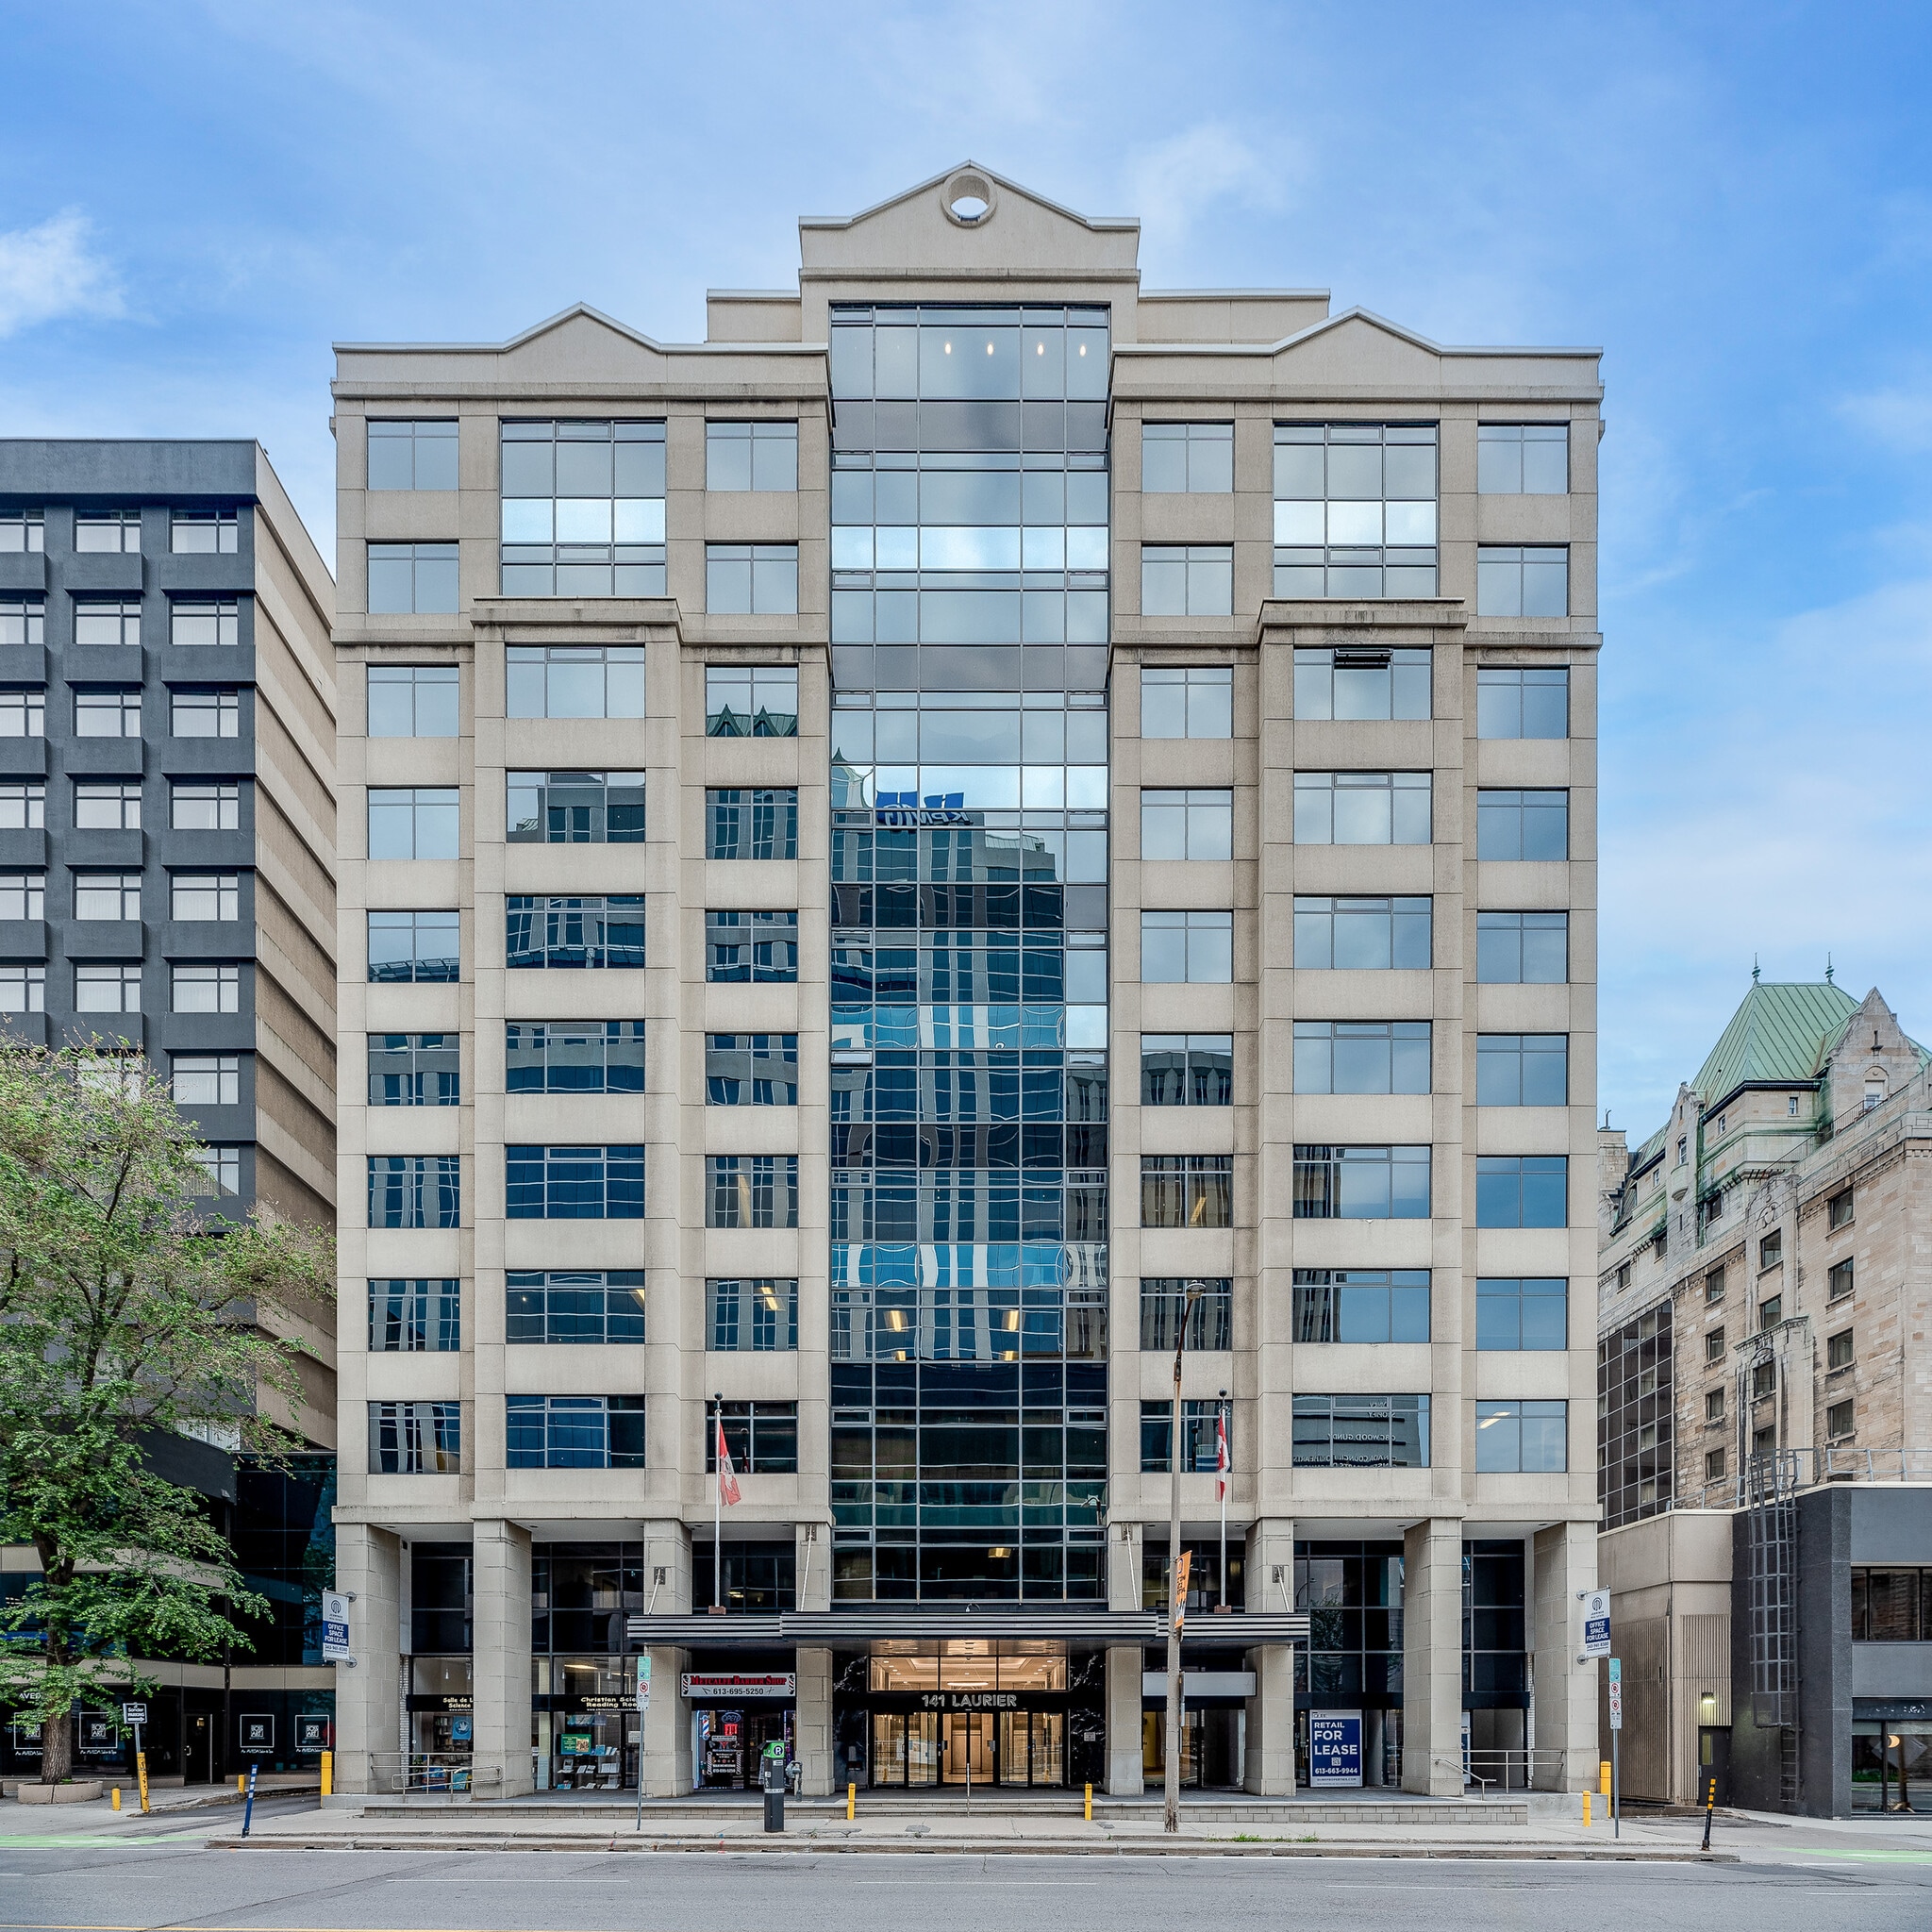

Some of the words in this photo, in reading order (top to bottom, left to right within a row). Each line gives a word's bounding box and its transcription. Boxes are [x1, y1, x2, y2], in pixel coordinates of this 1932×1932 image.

[922, 1694, 945, 1707] 141
[952, 1694, 1017, 1707] LAURIER
[1314, 1730, 1342, 1740] FOR
[1315, 1745, 1357, 1755] LEASE
